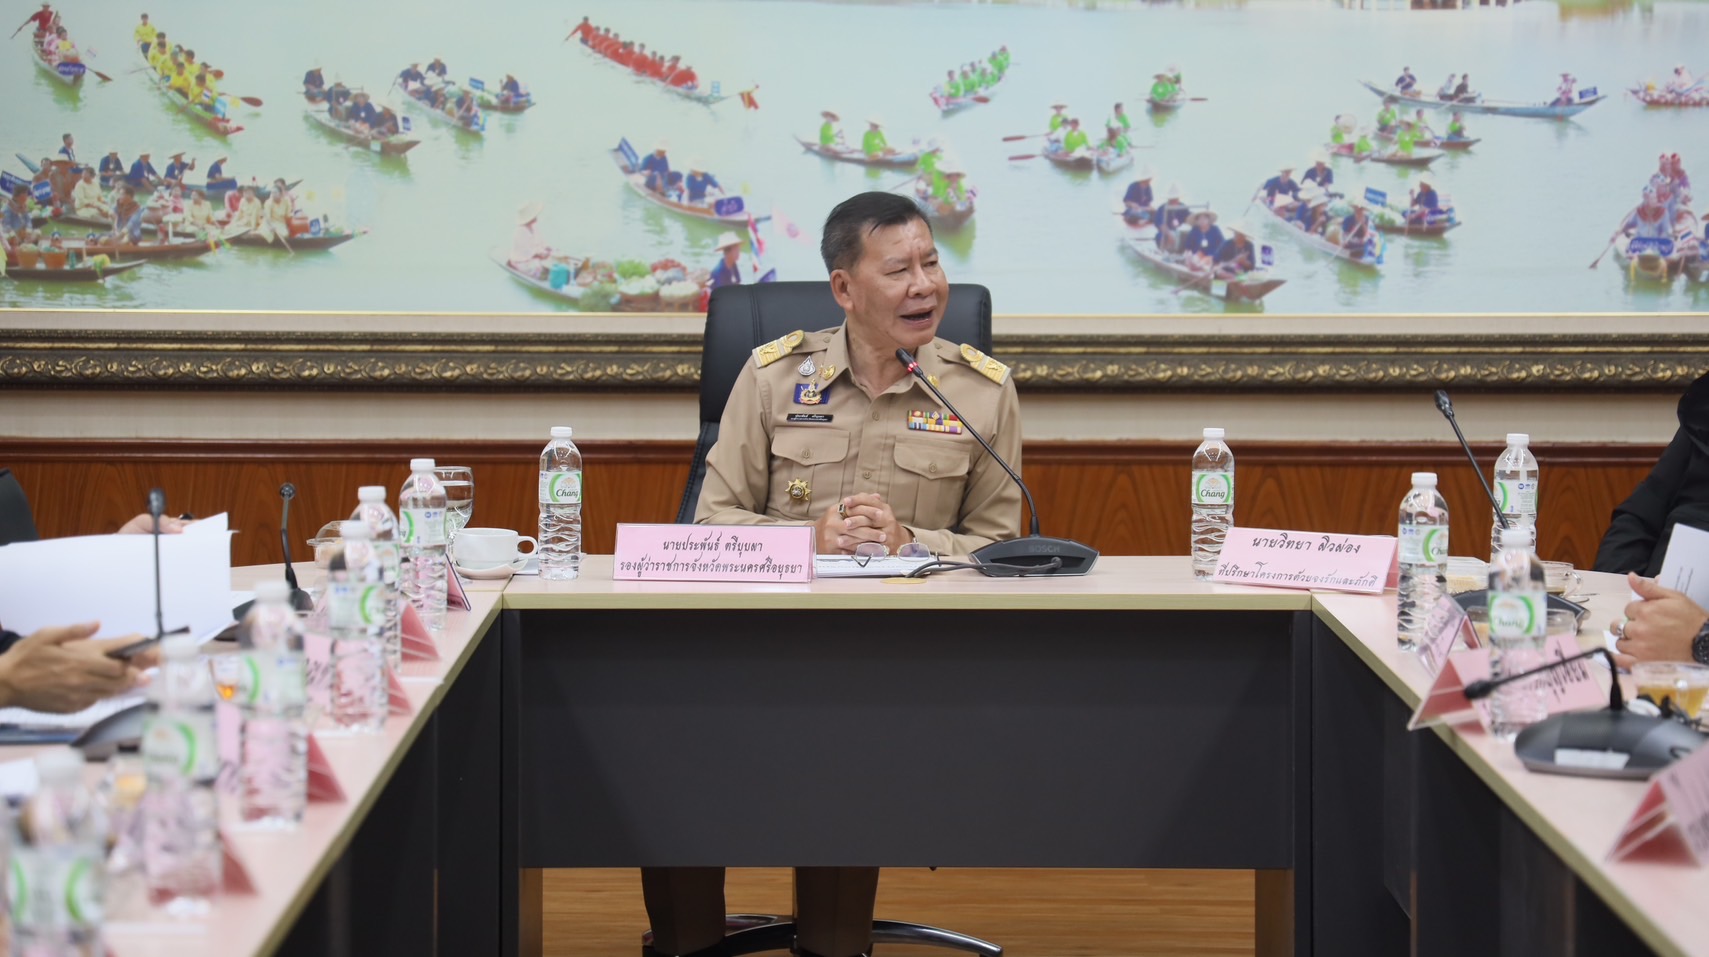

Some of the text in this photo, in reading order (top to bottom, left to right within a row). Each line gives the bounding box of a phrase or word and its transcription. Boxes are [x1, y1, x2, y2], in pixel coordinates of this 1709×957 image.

[555, 488, 579, 498] Chang
[1200, 488, 1226, 499] Chang
[663, 530, 763, 558] นายประพันธ์ ตรีบุบผา
[1252, 532, 1312, 550] นายวิทยา
[1028, 545, 1060, 553] BOSCH
[620, 552, 803, 580] รองผู้ว่าราชการจังหวัดพระนครศรีอยุธยา
